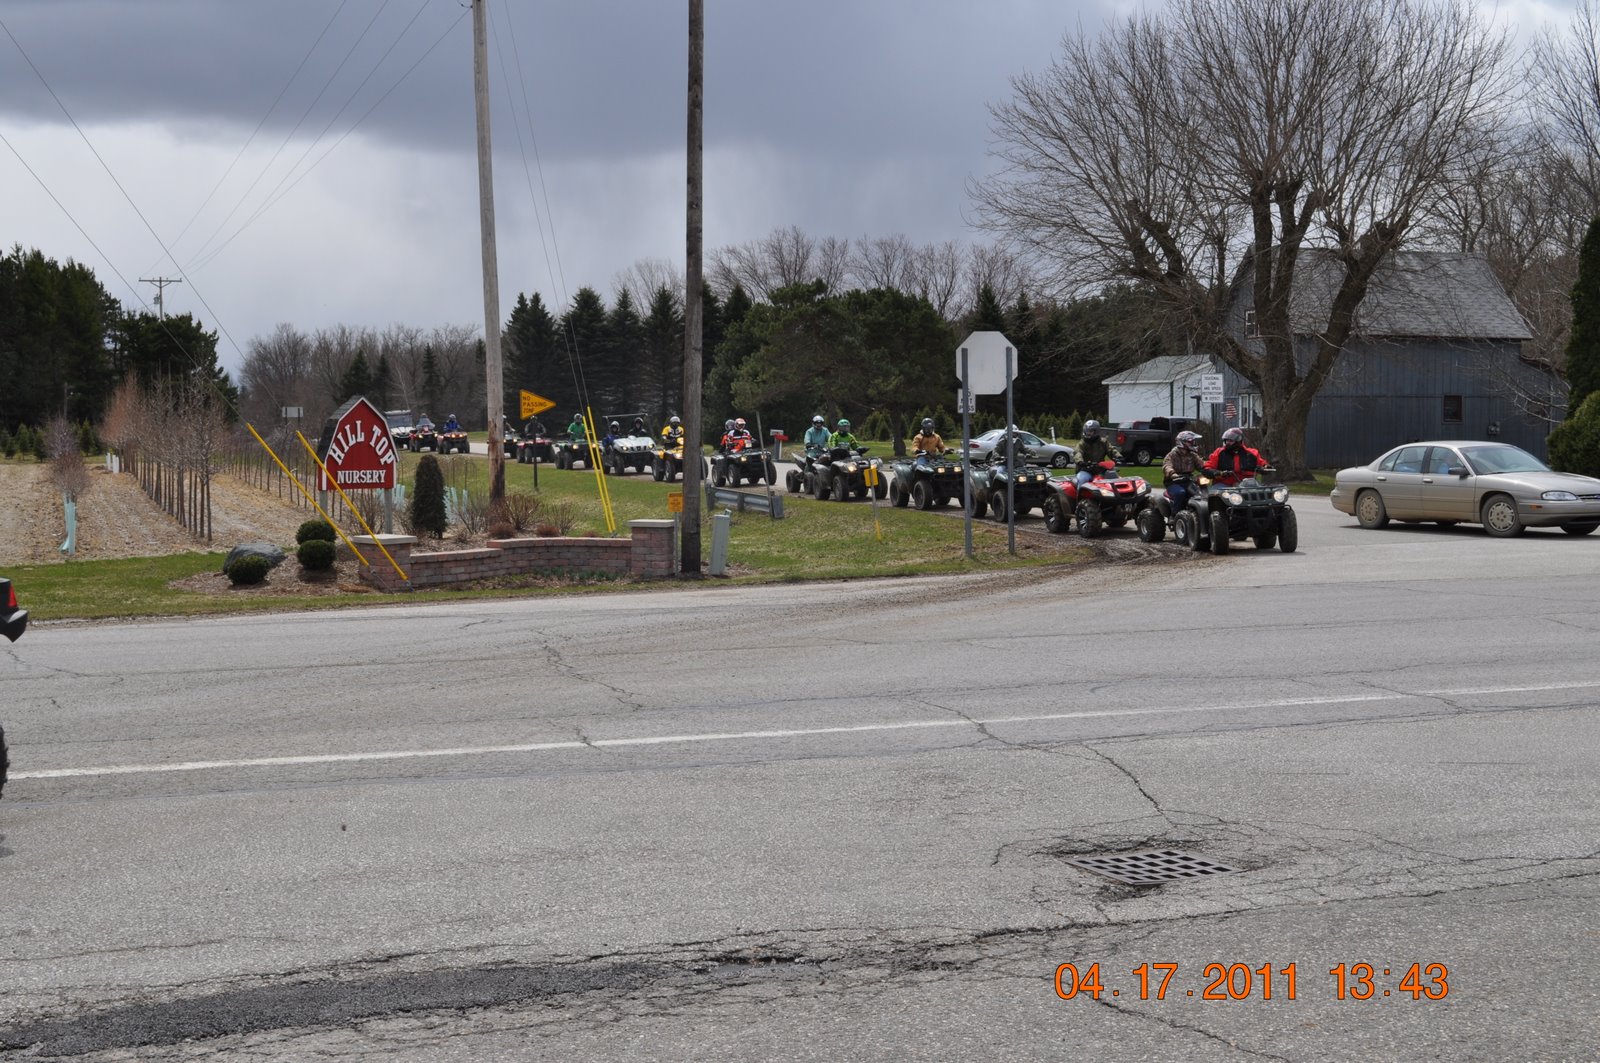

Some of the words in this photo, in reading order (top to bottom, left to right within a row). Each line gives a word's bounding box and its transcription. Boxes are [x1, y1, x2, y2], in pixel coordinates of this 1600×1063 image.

[959, 404, 975, 412] PSS
[328, 420, 365, 466] HILL
[369, 424, 396, 466] TOP
[336, 469, 387, 484] NURSERY
